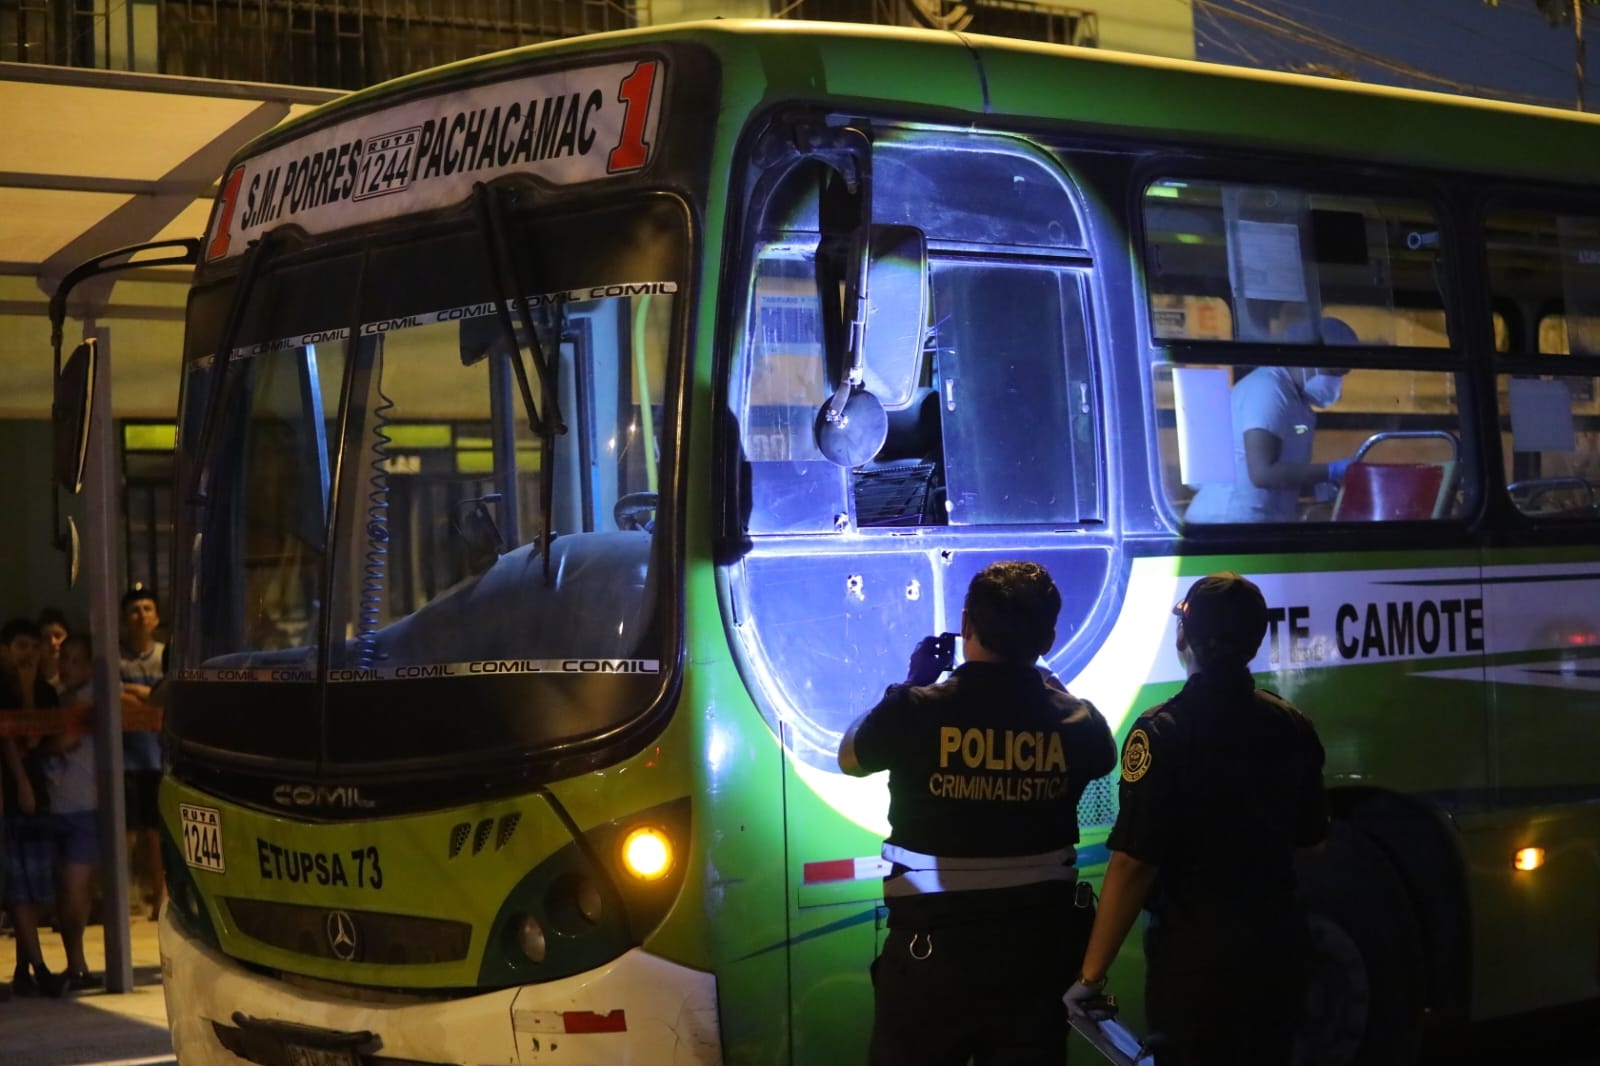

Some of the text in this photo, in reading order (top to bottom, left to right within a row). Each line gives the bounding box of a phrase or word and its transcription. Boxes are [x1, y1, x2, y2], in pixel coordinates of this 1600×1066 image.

[368, 134, 415, 153] RUTA
[411, 61, 657, 181] PACHACAMAC 1
[359, 147, 413, 195] 1244
[207, 139, 363, 263] 1 S.M. PORRES
[302, 329, 349, 345] COMIL
[366, 316, 423, 334] COMIL
[436, 303, 498, 322] COMIL
[590, 283, 678, 300] COMIL
[1335, 598, 1484, 660] CAMOTE
[217, 669, 259, 681] COMIL
[271, 669, 317, 681] COMIL
[330, 669, 384, 681] COMIL
[395, 664, 455, 678] COMIL
[469, 661, 541, 673] COMIL
[562, 660, 658, 673] COMIL
[939, 725, 1068, 773] POLICIA
[182, 808, 217, 823] RUTA
[272, 784, 376, 808] COMIL
[184, 822, 221, 868] 1244
[256, 836, 383, 890] ETUPSA 73
